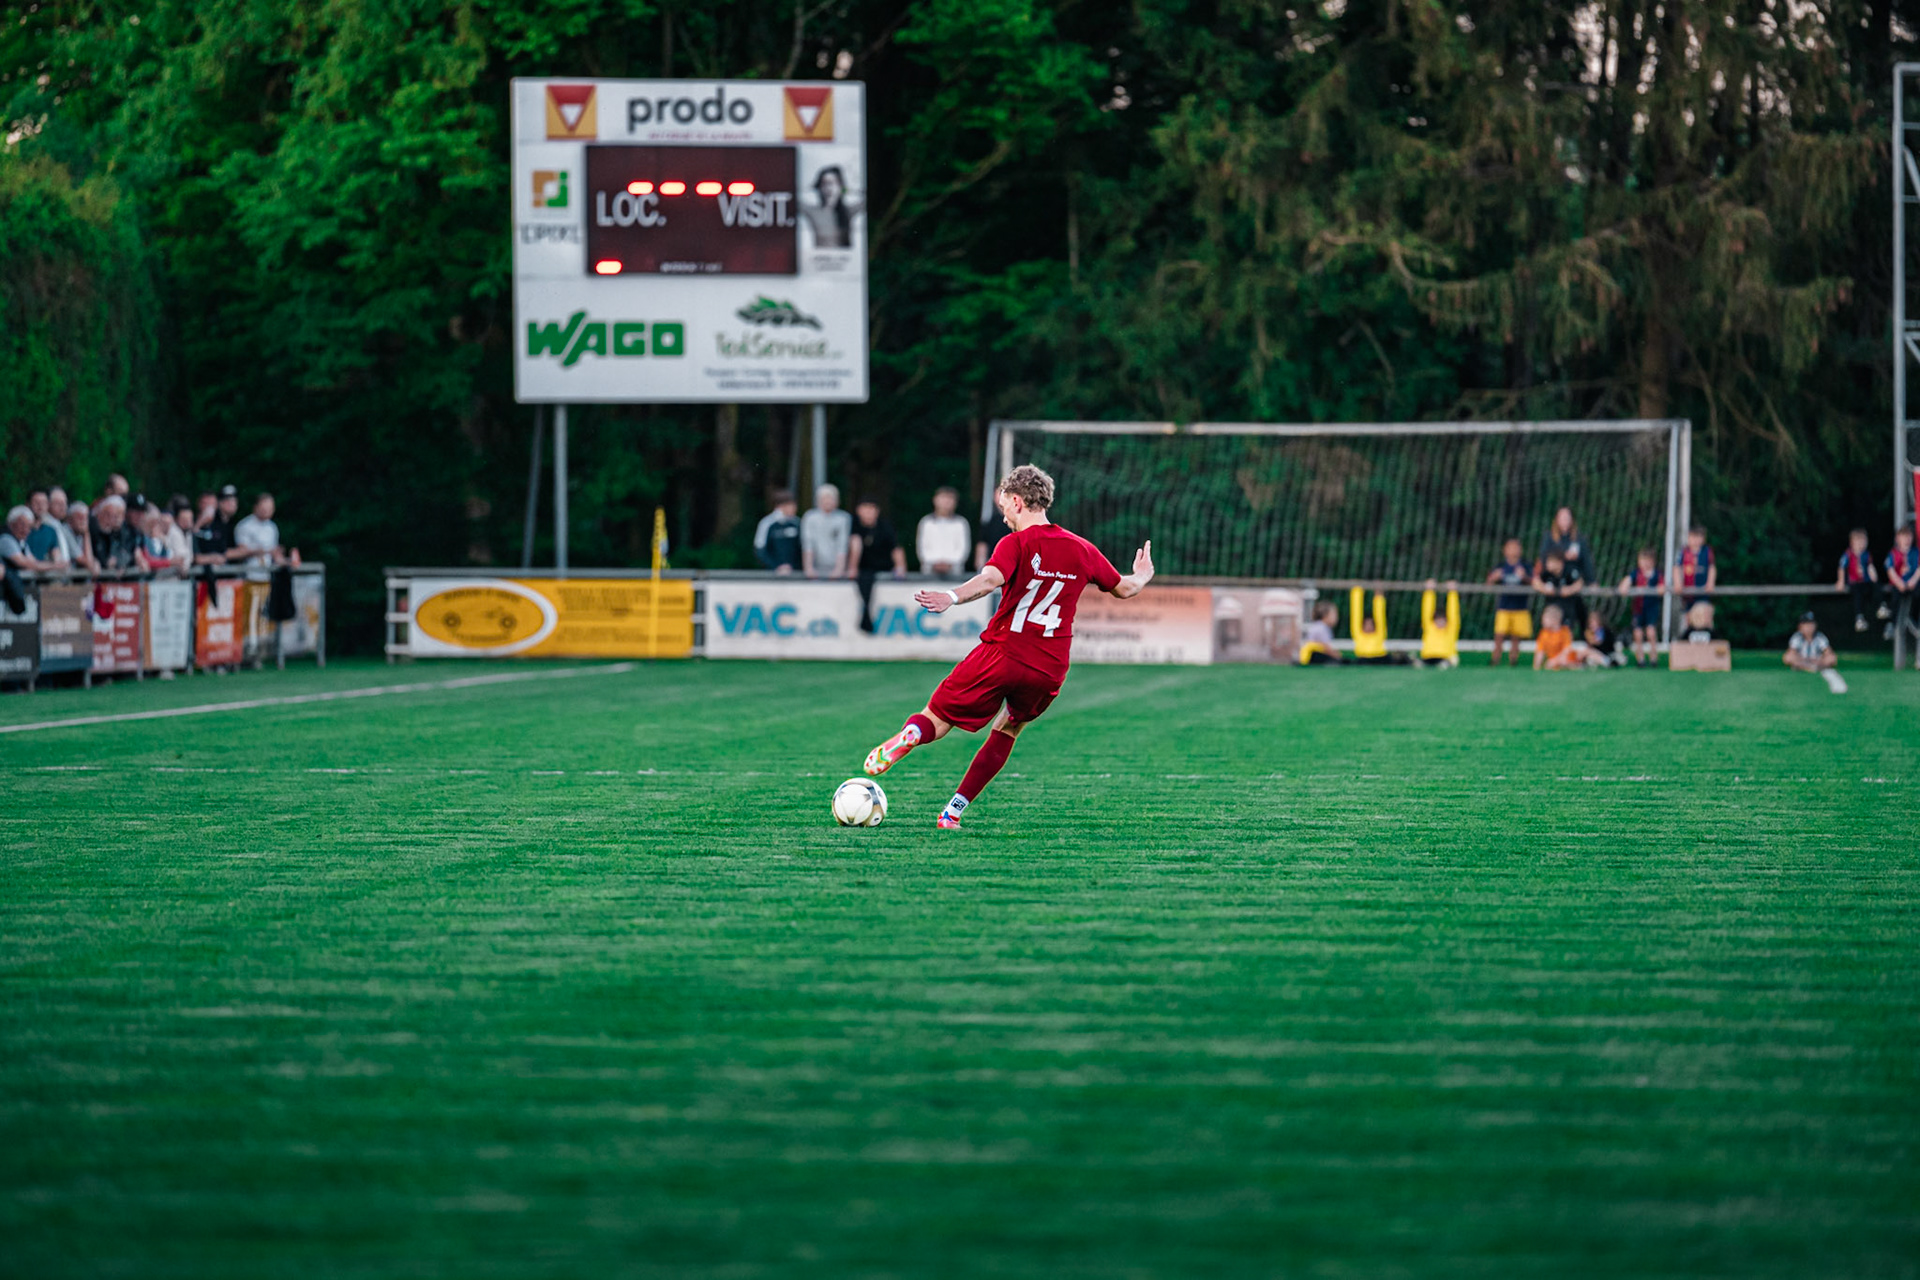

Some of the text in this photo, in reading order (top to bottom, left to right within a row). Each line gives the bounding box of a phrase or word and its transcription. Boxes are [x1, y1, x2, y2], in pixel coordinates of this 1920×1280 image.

[627, 87, 754, 134] prodo
[596, 191, 796, 227] LOC. VISIT.
[527, 310, 685, 368] WAGO
[716, 603, 841, 637] VAC.ch
[1010, 578, 1065, 638] 14
